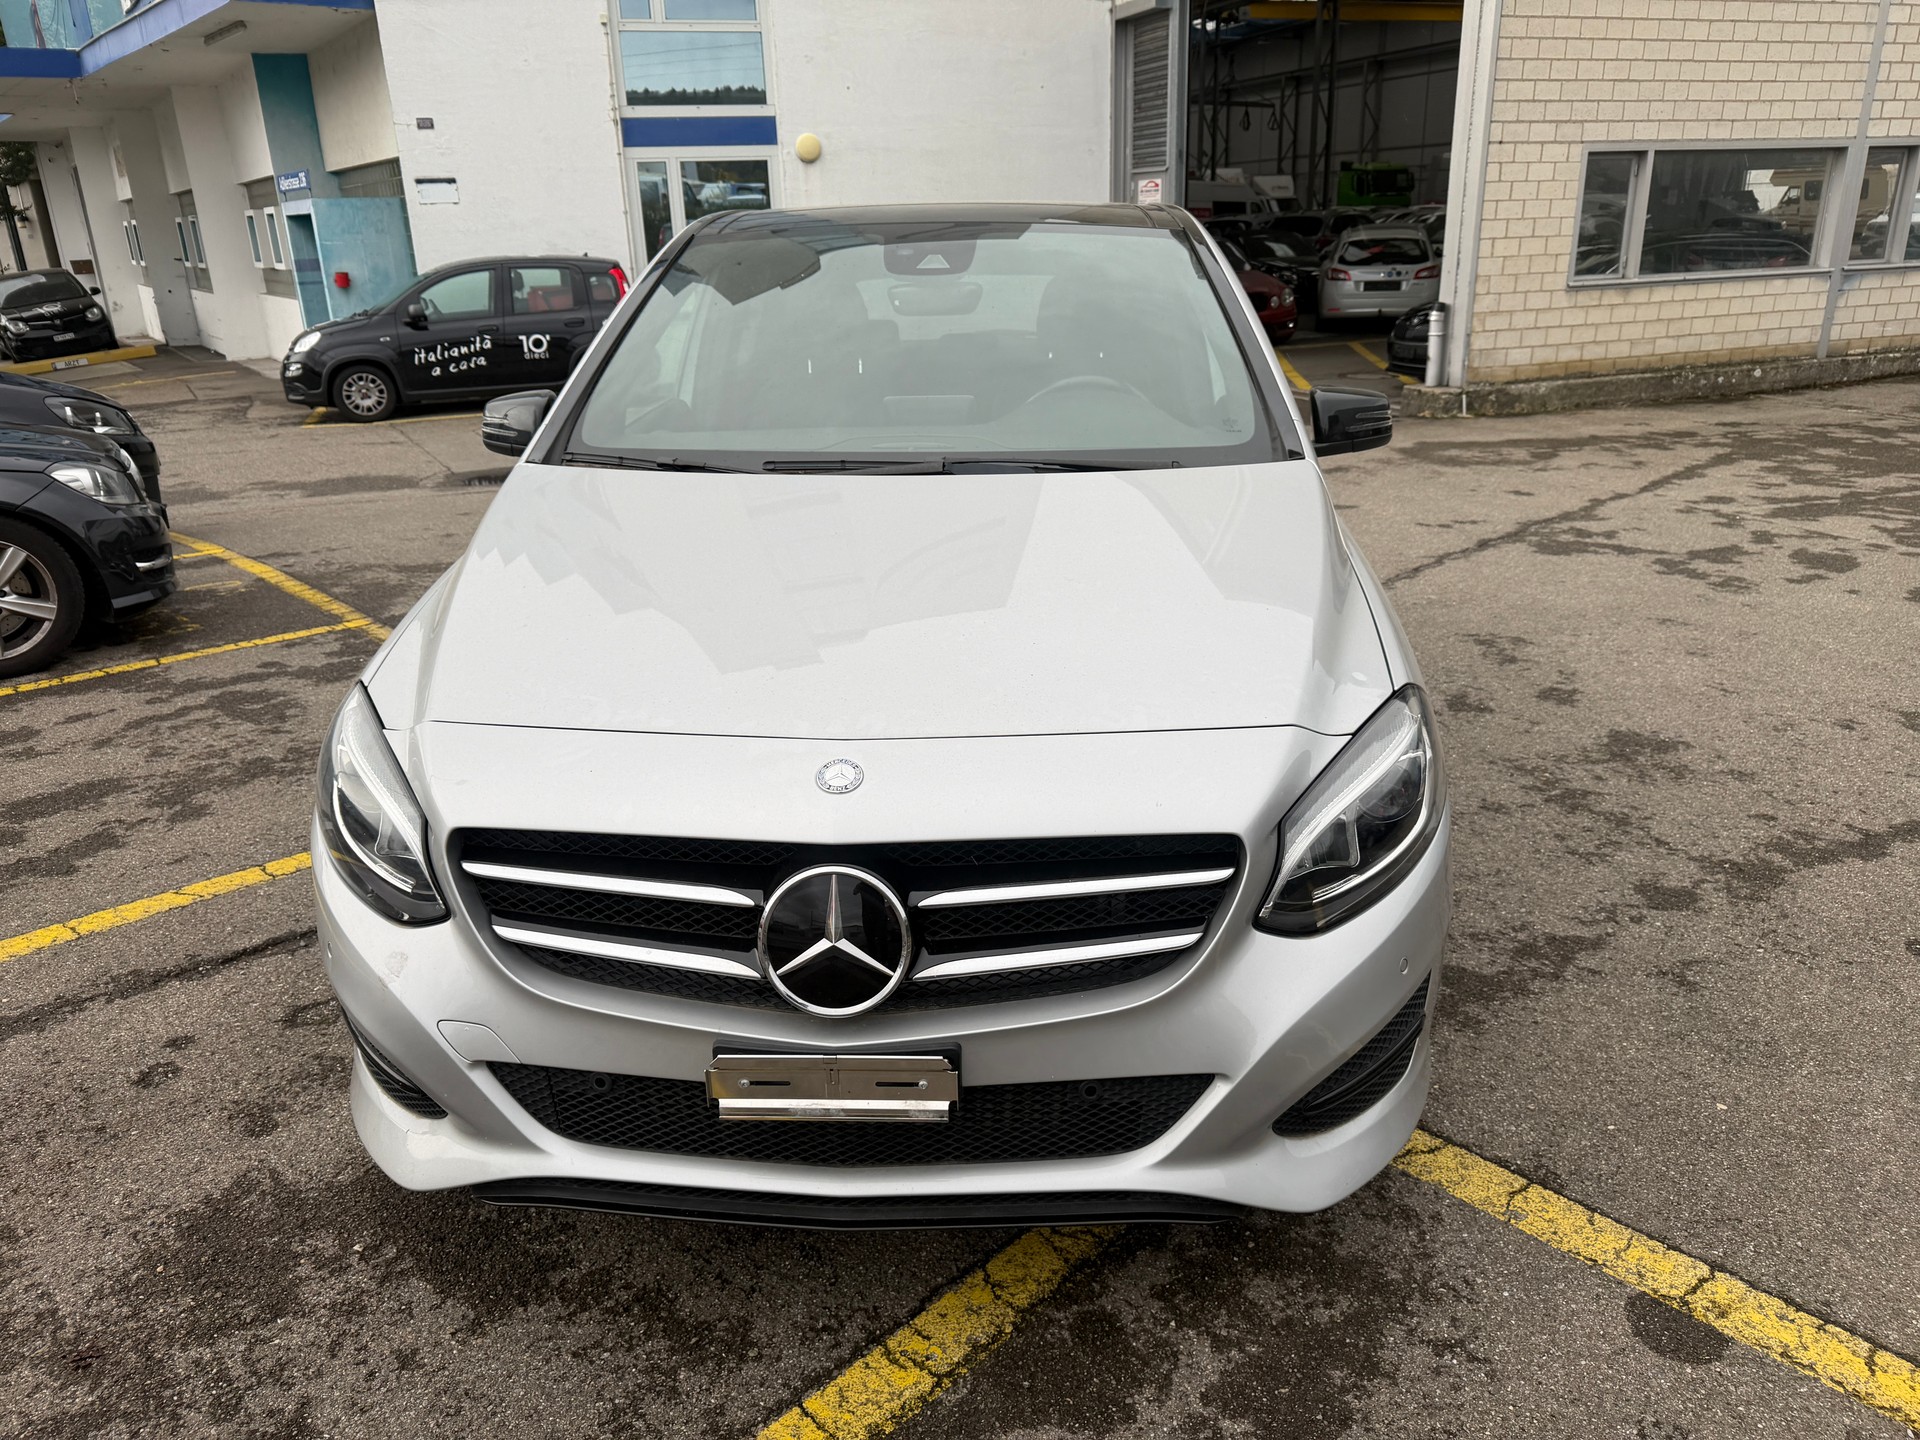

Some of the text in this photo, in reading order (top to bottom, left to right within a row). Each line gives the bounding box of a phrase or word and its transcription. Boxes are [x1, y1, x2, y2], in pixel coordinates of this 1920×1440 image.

[414, 334, 492, 365] italianità
[524, 351, 549, 360] dieci
[431, 356, 487, 376] a casa
